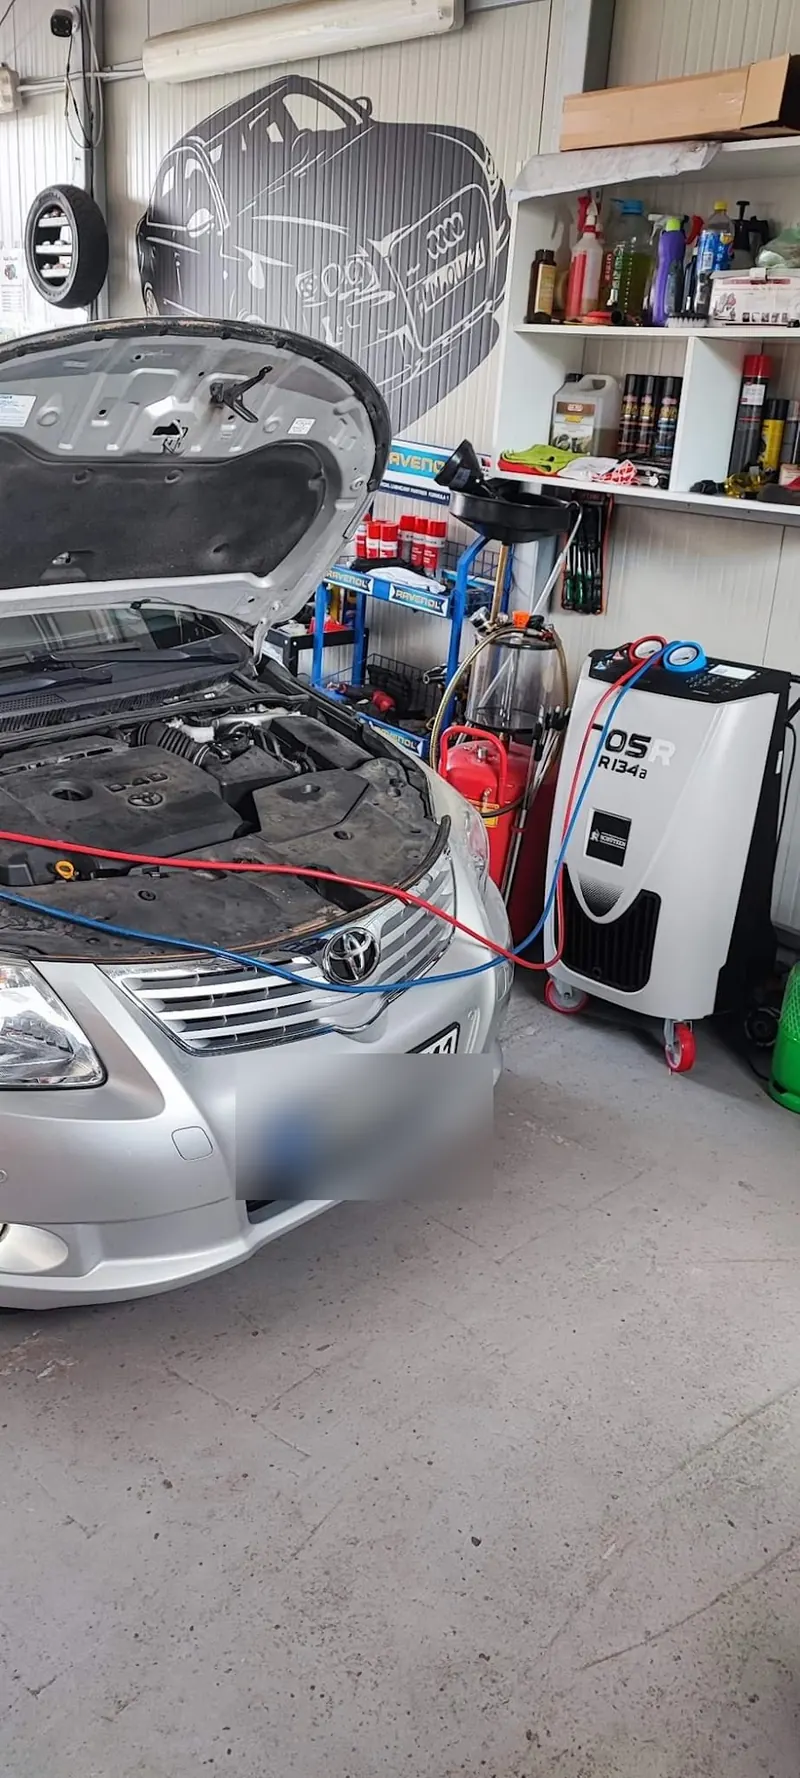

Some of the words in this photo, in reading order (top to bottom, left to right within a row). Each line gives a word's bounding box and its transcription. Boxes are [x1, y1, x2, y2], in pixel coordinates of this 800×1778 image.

[388, 452, 446, 474] AVENO
[326, 570, 368, 588] RAVENOL
[395, 590, 441, 609] RAVENOL
